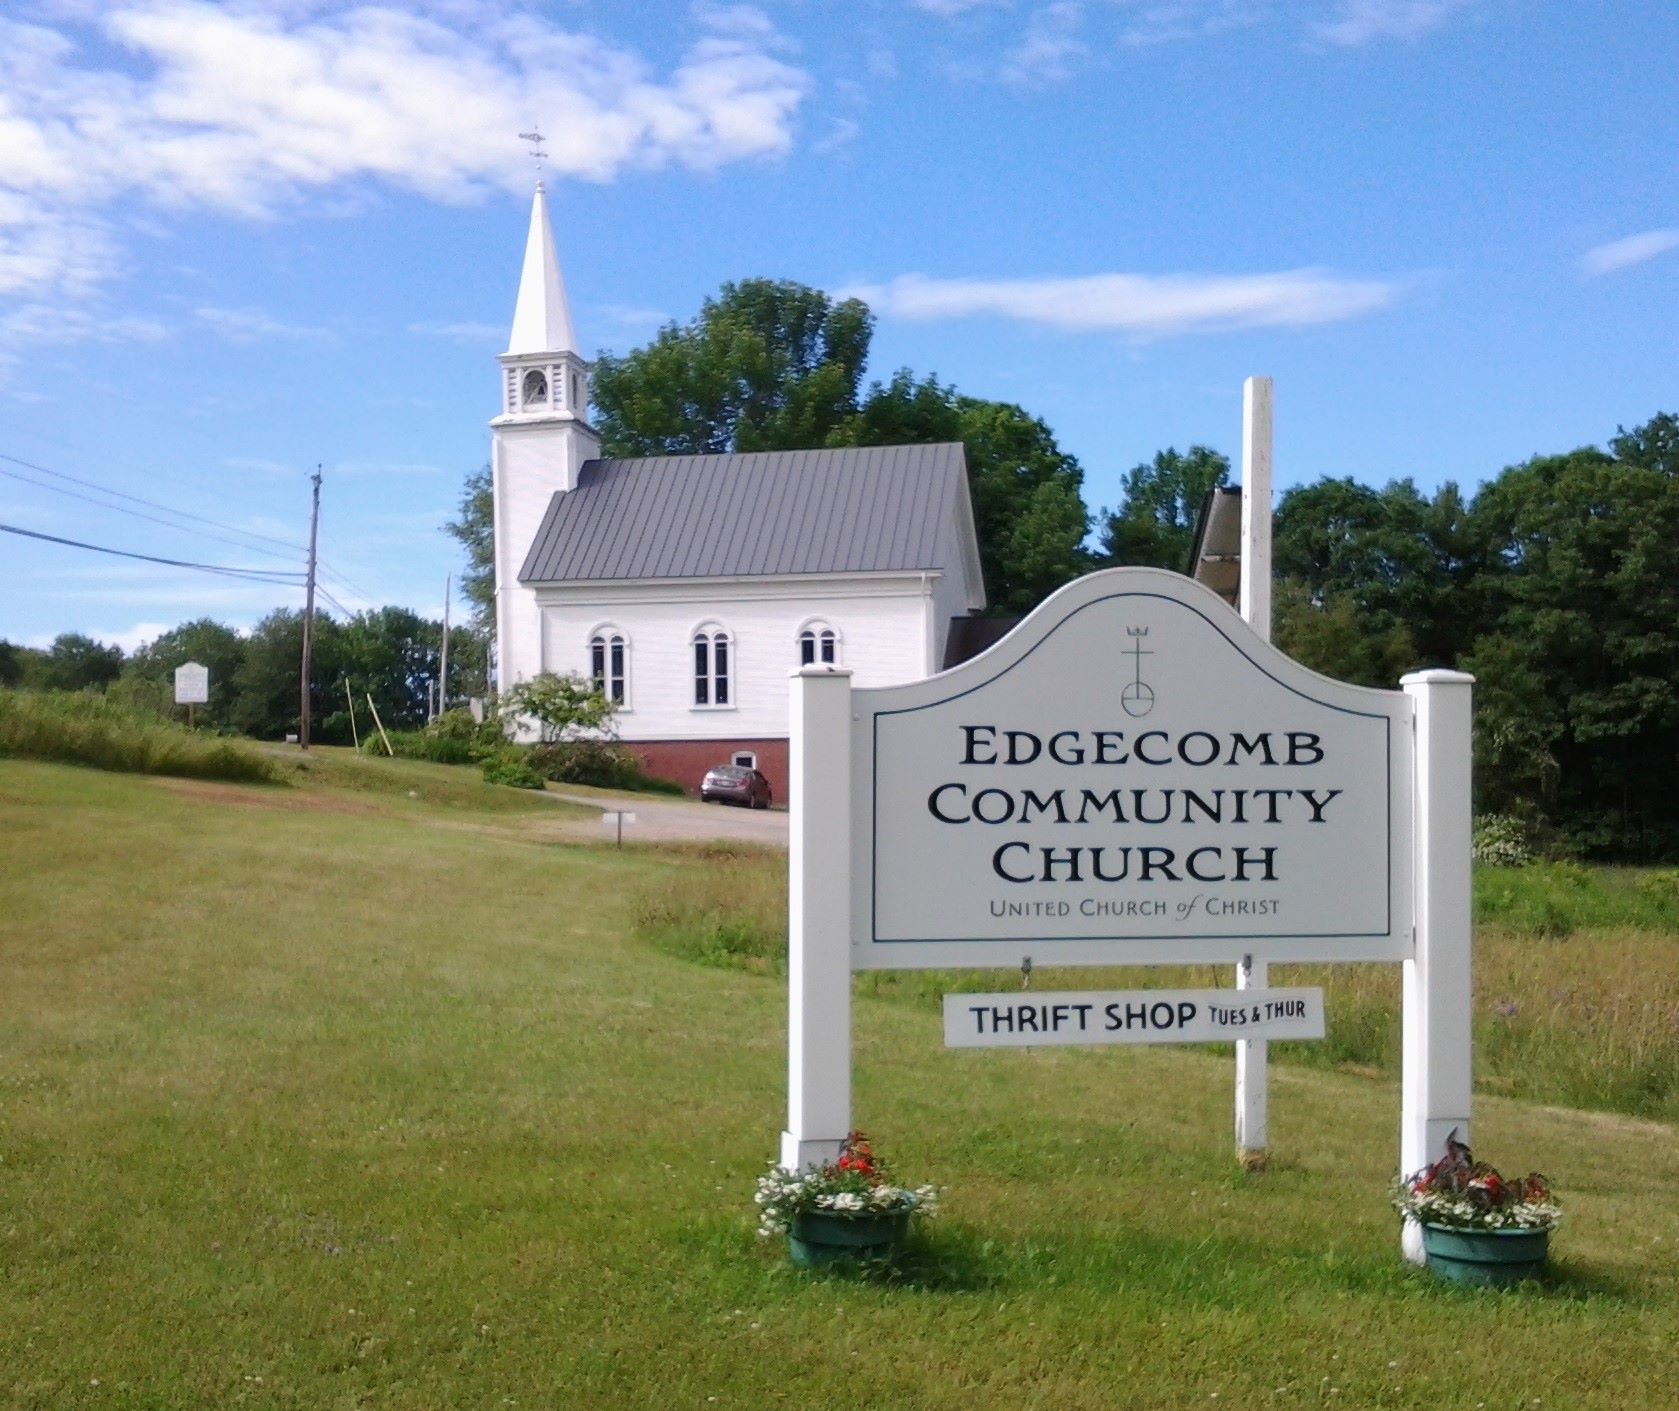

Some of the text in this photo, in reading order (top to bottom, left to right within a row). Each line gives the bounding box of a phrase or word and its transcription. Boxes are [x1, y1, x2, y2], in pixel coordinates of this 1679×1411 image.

[960, 725, 1325, 765] EDGECOMB
[927, 783, 1343, 824] COMMUNITY
[992, 842, 1279, 882] CHURCH
[990, 894, 1280, 921] UNITED CHURCH of CHRIST
[969, 1001, 1305, 1033] THRIFT SHOP TUES & THUR
